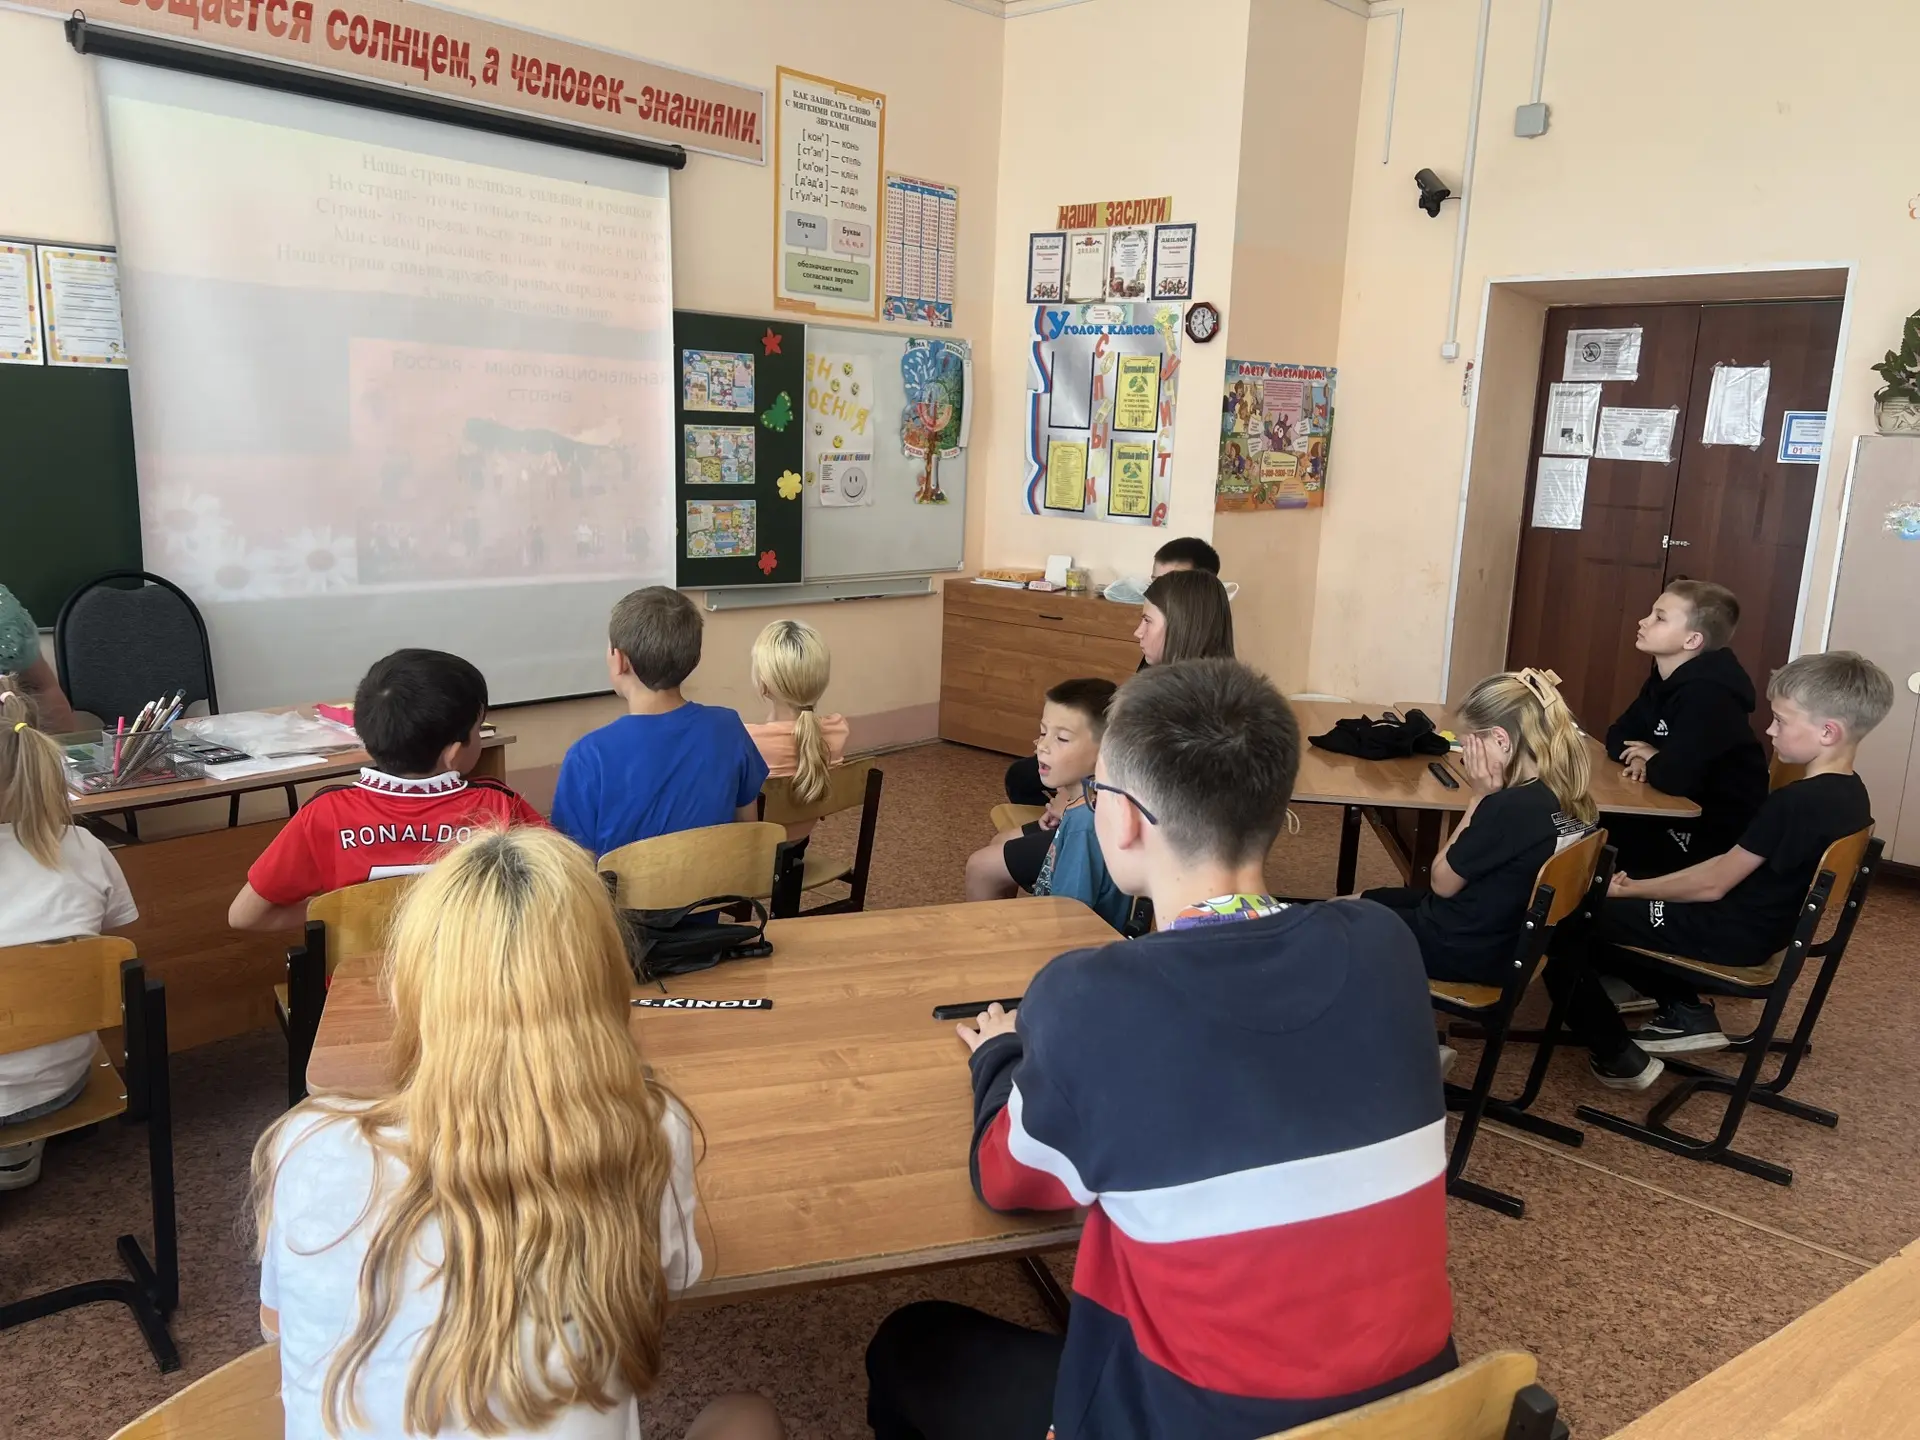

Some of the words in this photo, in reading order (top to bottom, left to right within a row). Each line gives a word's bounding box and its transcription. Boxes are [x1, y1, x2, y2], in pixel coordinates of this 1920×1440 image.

[326, 9, 477, 88] солнцем,
[482, 46, 500, 86] а
[792, 90, 809, 101] КАК
[810, 94, 848, 110] ЗАПИСАТЬ
[848, 104, 871, 116] СЛОВО
[785, 99, 791, 107] С
[792, 100, 828, 115] МЯГКИМИ
[830, 110, 877, 128] СОГЛАСНЫМИ
[815, 117, 850, 131] ЗВУКАМИ
[841, 141, 860, 151] конь
[362, 153, 407, 176] Наша
[411, 166, 462, 187] страна
[841, 155, 861, 167] степь
[328, 171, 353, 190] Но
[450, 197, 468, 211] не
[840, 200, 867, 212] тюлень
[797, 218, 816, 229] Буква
[842, 226, 861, 237] Буквы
[333, 224, 364, 244] Мы
[382, 237, 421, 252] вами
[330, 254, 385, 274] страна
[797, 260, 833, 272] обозначают
[833, 266, 859, 276] мягкость
[802, 272, 833, 282] согласных
[1046, 310, 1105, 340] Уголок
[1792, 446, 1803, 454] 01
[339, 824, 472, 850] RONALDO
